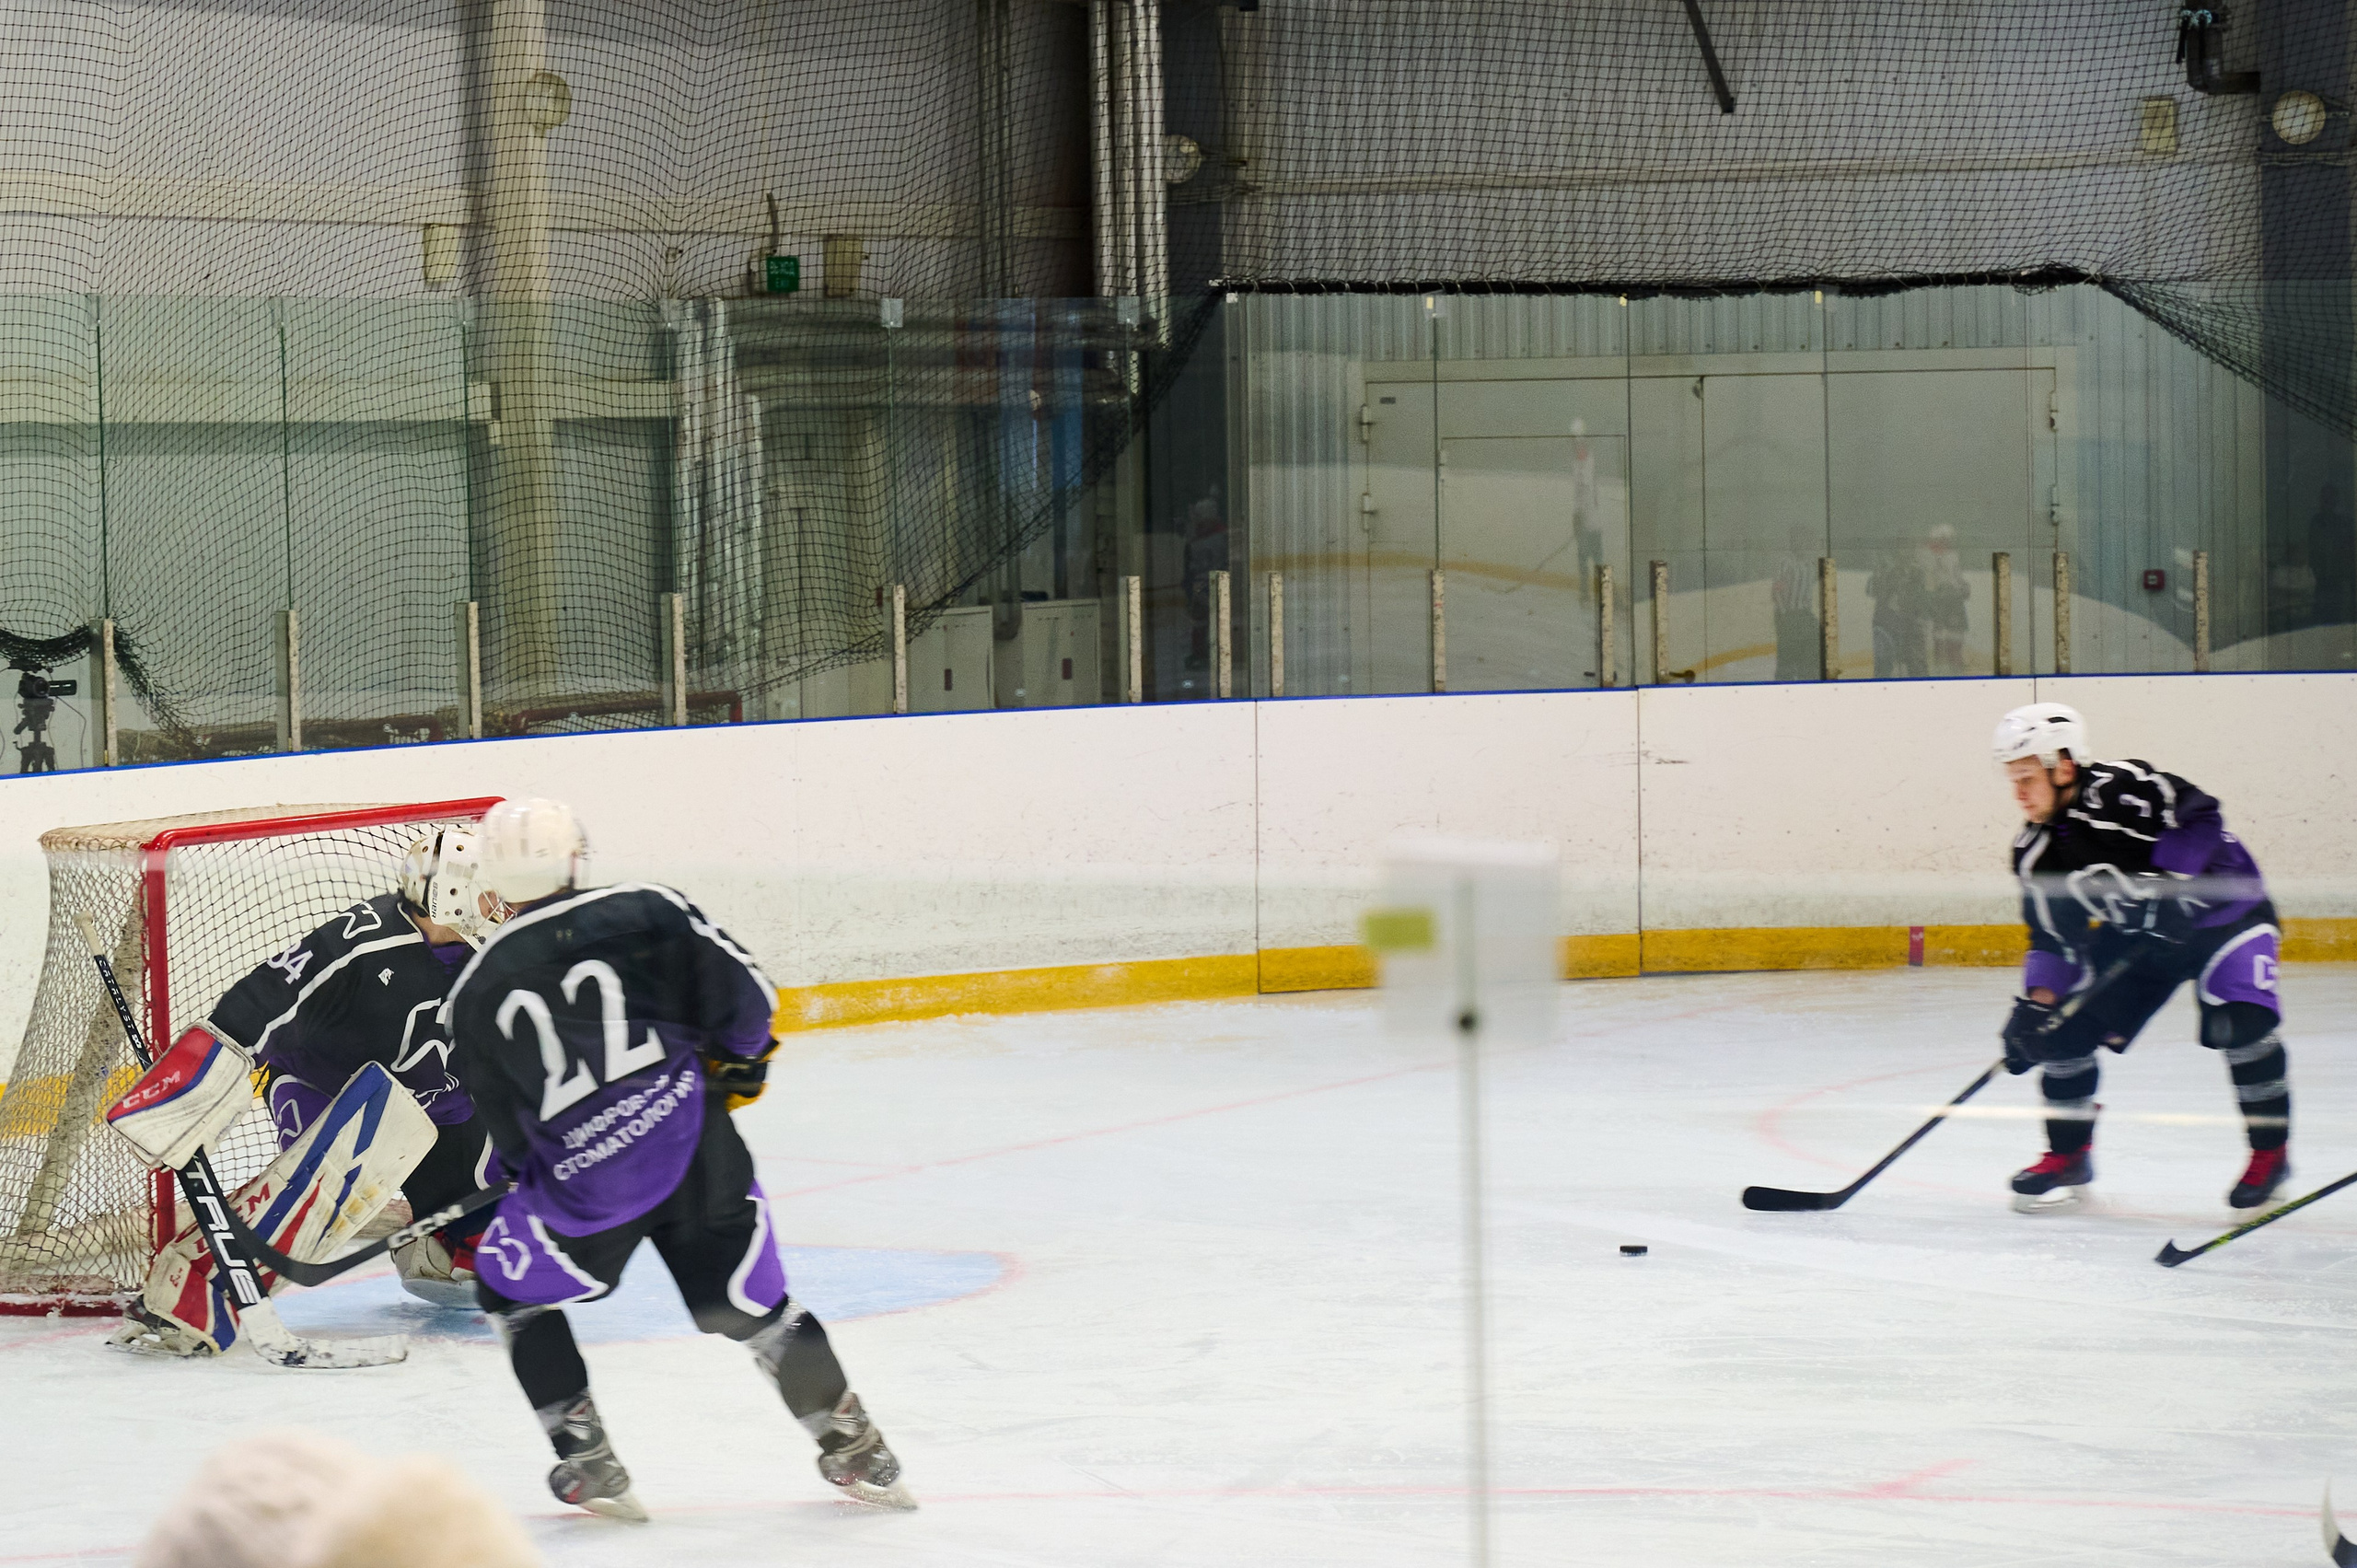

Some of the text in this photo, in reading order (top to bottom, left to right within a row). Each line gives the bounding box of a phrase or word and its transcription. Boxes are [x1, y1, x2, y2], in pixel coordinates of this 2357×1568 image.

[99, 959, 135, 1030] CATALYST
[494, 958, 668, 1122] 22
[122, 1070, 181, 1109] CCM
[185, 1157, 263, 1305] TRUE
[387, 1203, 465, 1249] CCM
